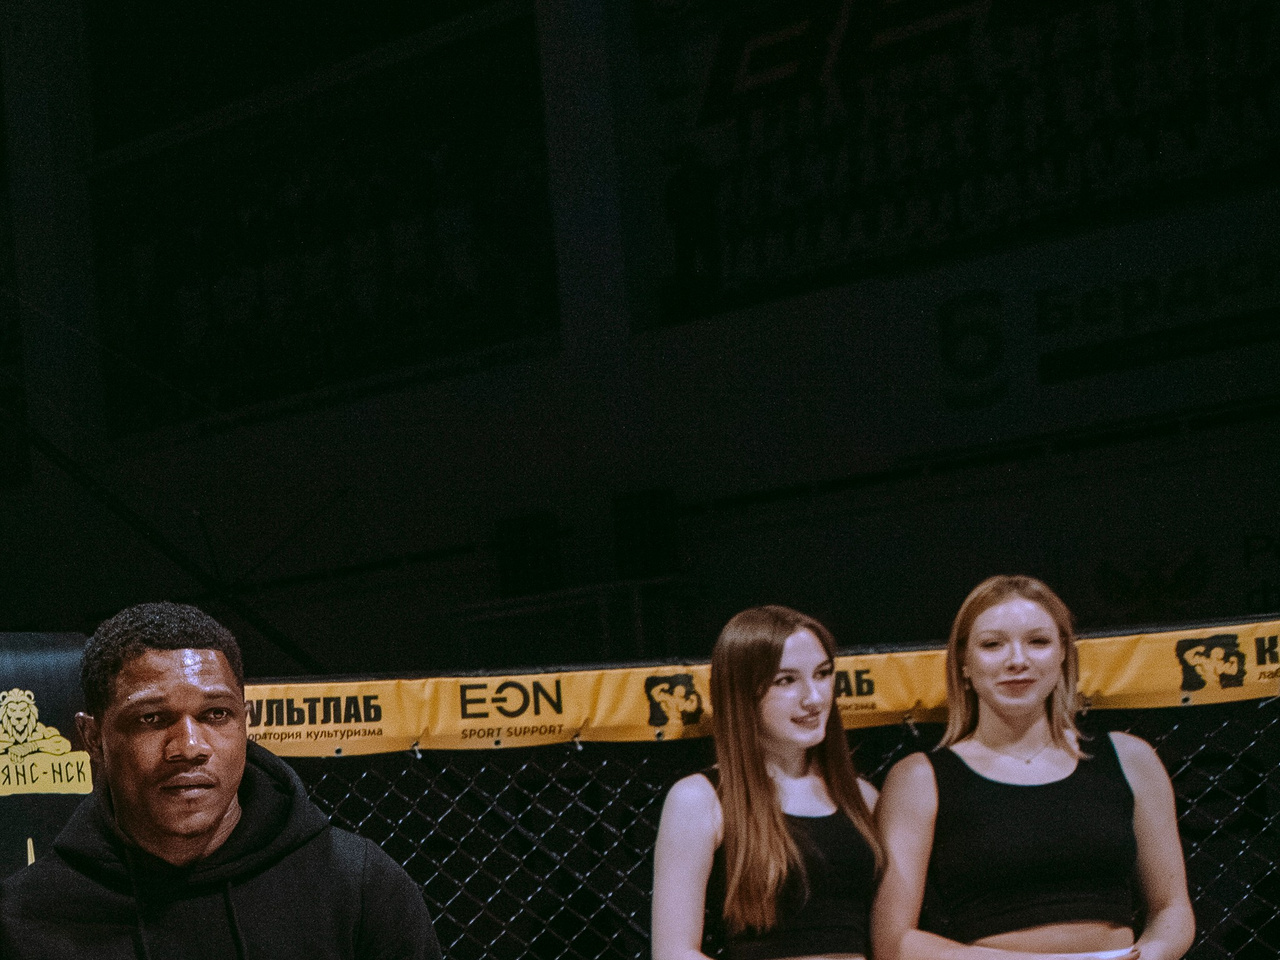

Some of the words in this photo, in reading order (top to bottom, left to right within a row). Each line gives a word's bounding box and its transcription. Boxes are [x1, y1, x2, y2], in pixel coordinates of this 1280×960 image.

[246, 695, 382, 727] УЛЬТЛАБ
[460, 680, 563, 719] EON
[248, 731, 302, 742] оратория
[306, 727, 383, 741] культуризма
[461, 728, 502, 739] SPORT
[506, 724, 564, 737] SUPPORT
